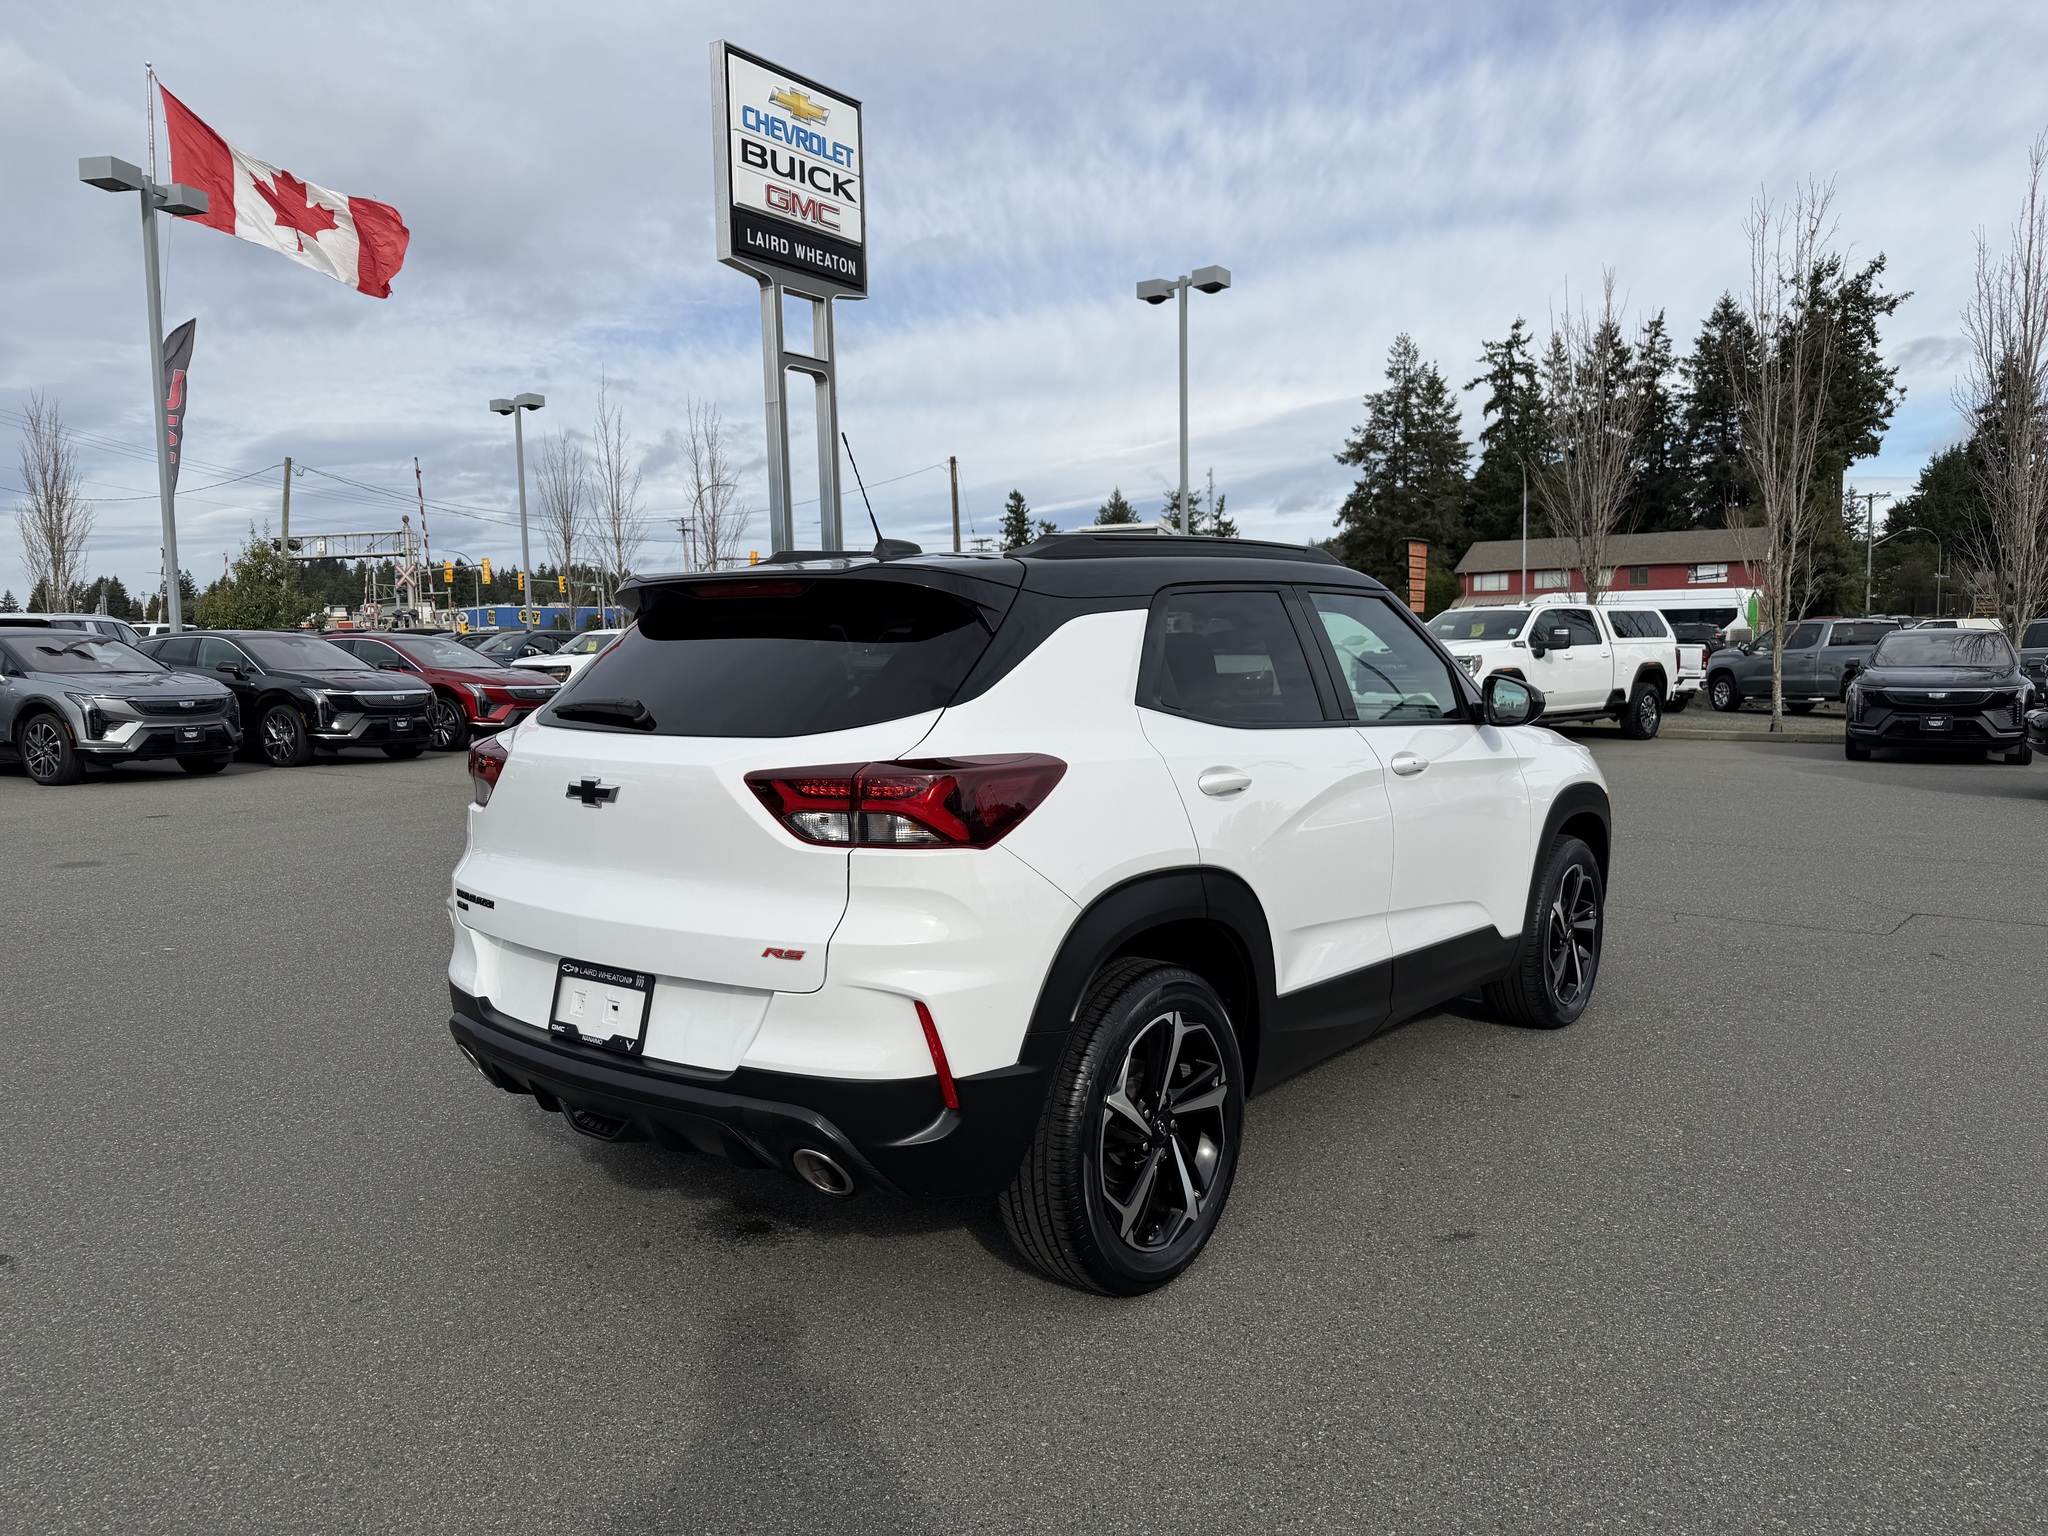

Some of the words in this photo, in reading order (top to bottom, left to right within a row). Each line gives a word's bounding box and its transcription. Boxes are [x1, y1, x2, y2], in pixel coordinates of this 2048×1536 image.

[742, 104, 854, 168] CHEVROLET
[741, 138, 857, 203] BUICK
[765, 181, 841, 231] GMC
[746, 228, 789, 255] LAIRD
[794, 242, 856, 276] WHEATON
[579, 967, 597, 977] LAIRD
[598, 971, 630, 984] WHEATON
[761, 947, 807, 961] RS
[552, 1024, 565, 1032] GMC
